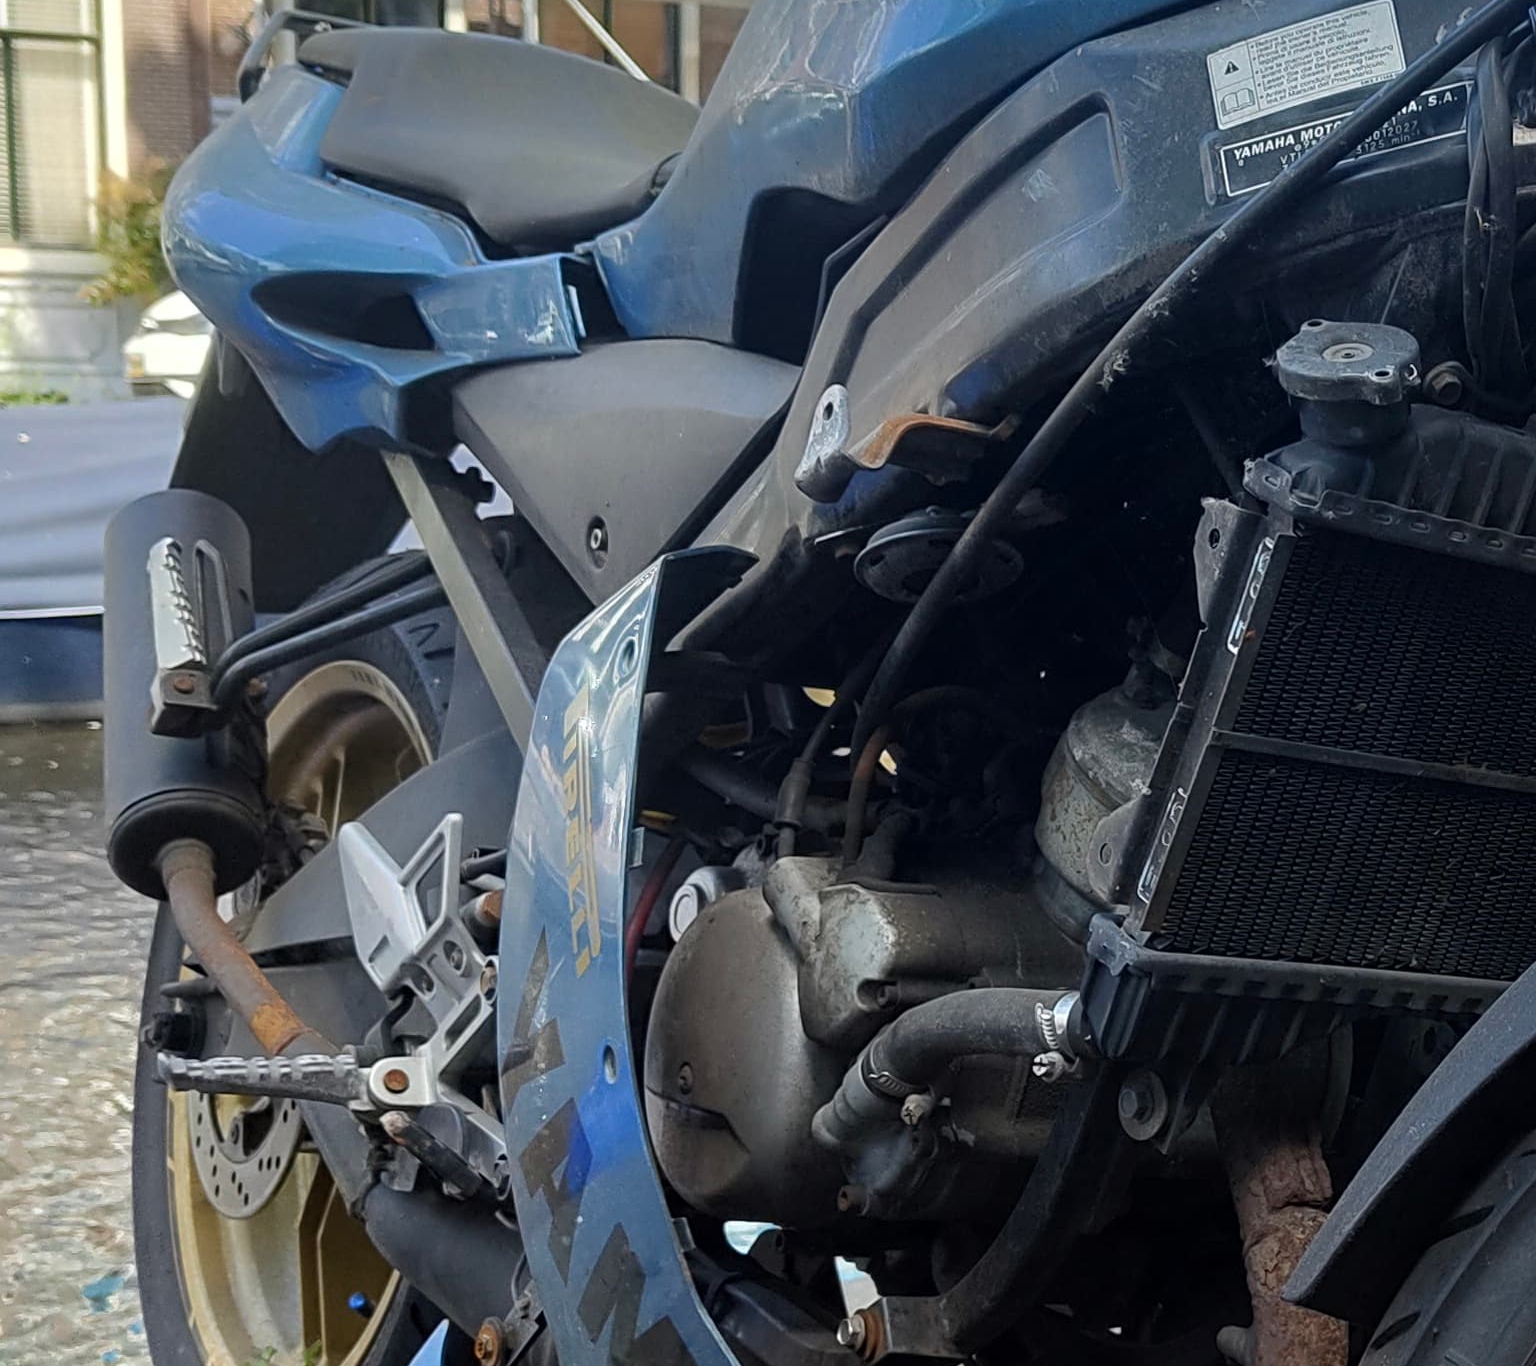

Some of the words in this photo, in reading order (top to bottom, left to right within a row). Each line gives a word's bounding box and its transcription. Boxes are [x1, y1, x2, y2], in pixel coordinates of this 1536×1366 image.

[1233, 134, 1295, 160] YAMAHA
[1299, 120, 1343, 142] MOT
[562, 682, 601, 979] PIRELLI
